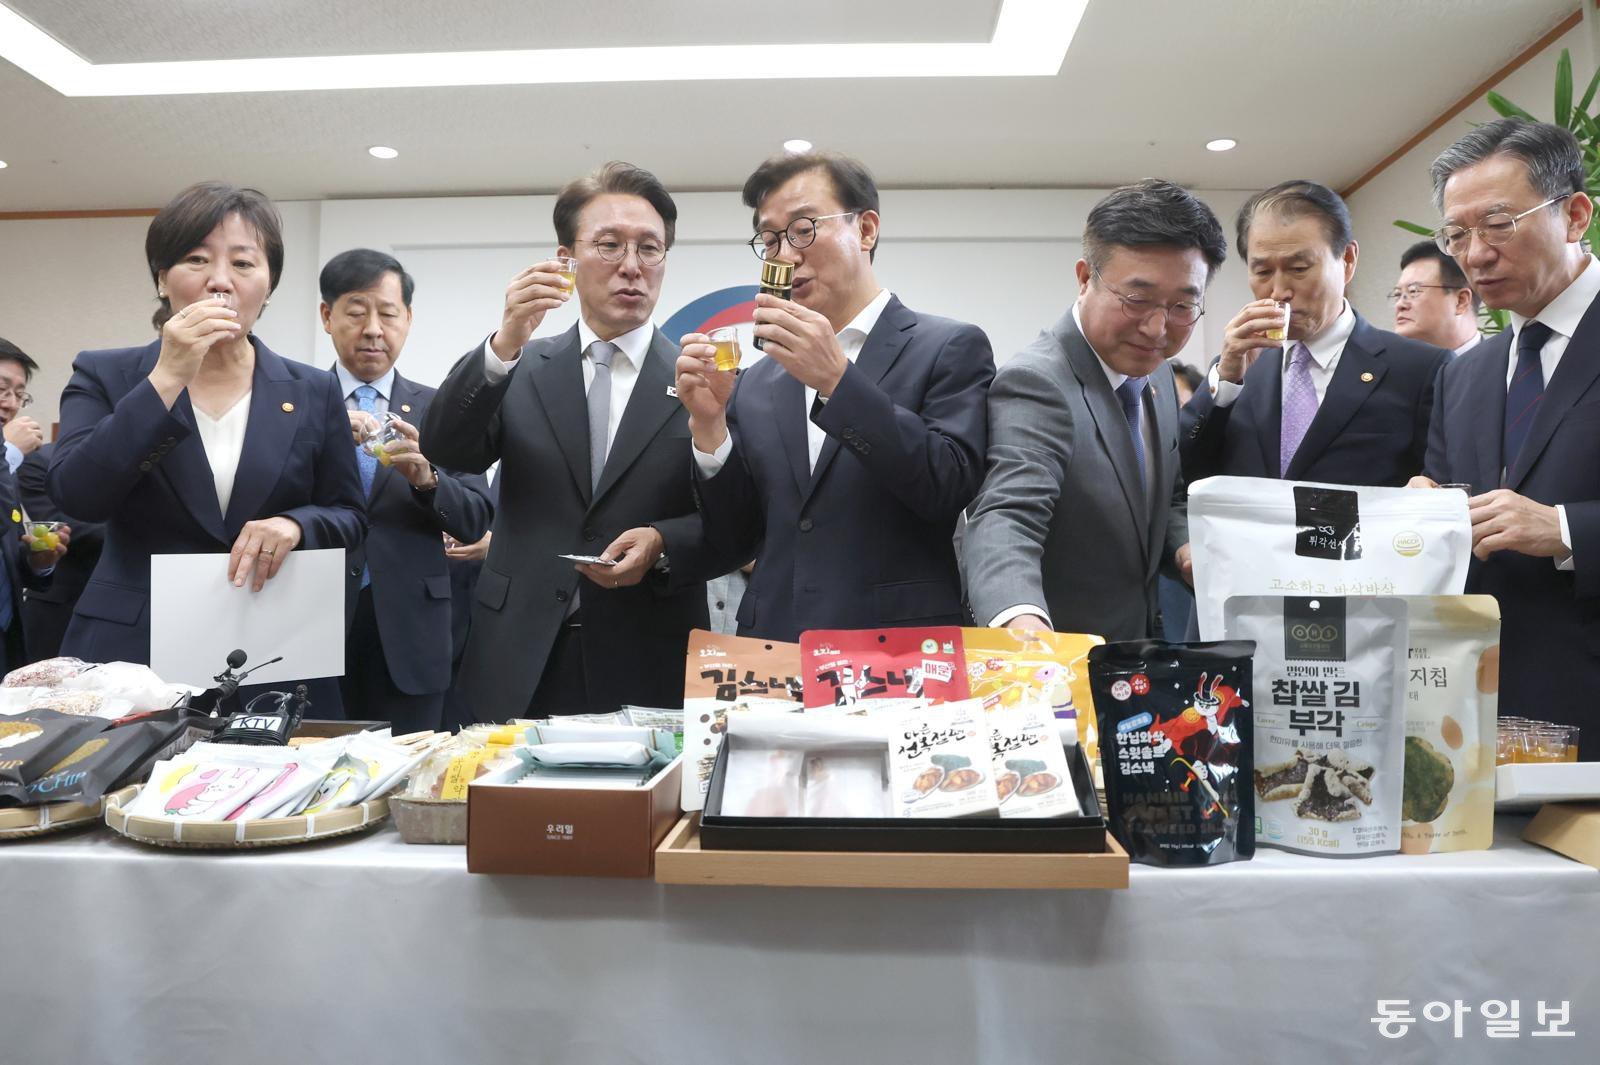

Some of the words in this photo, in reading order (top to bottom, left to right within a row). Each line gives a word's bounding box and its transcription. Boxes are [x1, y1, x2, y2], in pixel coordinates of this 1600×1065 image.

[1286, 665, 1319, 678] 명인이
[1323, 667, 1347, 679] 만든
[1409, 667, 1447, 688] 지칩
[1271, 679, 1329, 706] 찹쌀
[1333, 681, 1360, 708] 김
[239, 718, 276, 730] KTV
[1289, 710, 1346, 738] 부각
[1120, 761, 1155, 776] 김스낵
[546, 823, 574, 835] 우리밀
[1308, 826, 1319, 836] 30
[1321, 830, 1328, 838] g
